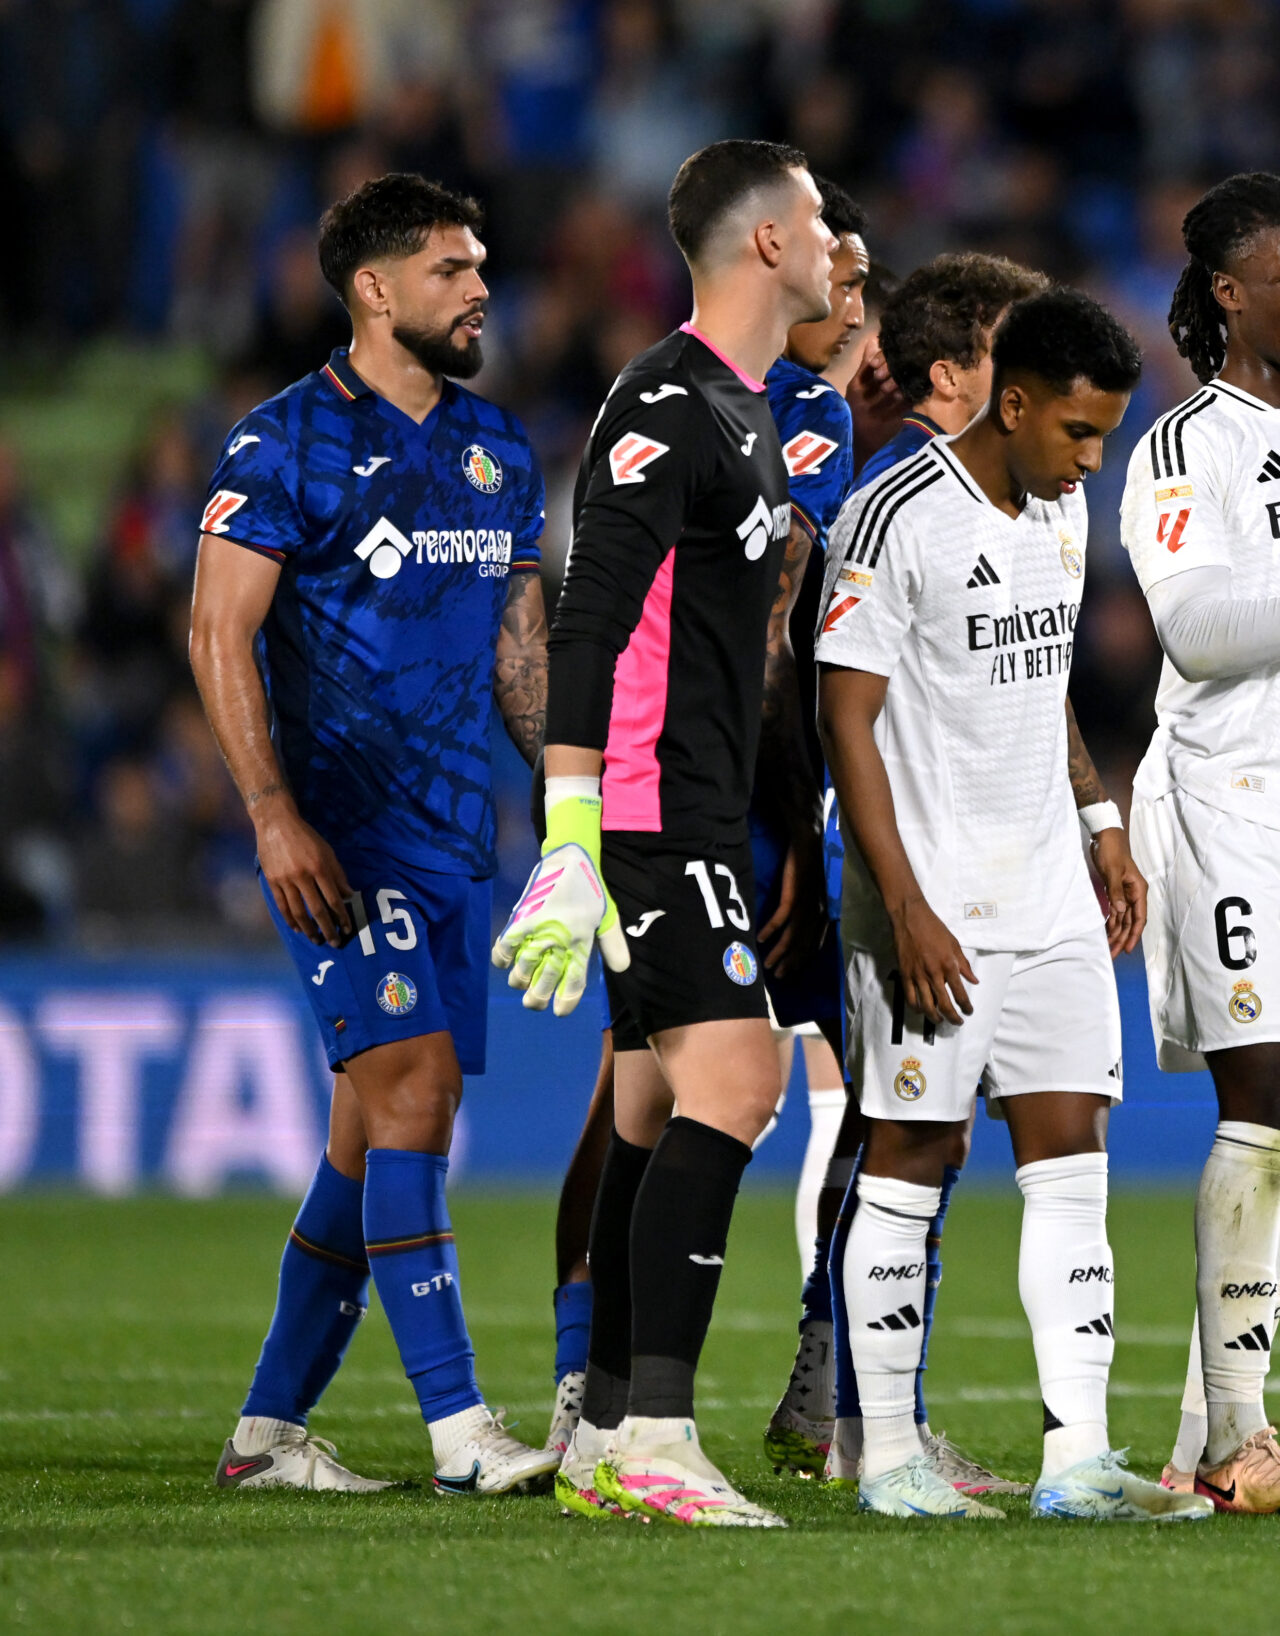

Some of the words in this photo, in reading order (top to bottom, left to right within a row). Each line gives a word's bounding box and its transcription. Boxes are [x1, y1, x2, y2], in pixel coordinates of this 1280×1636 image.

[412, 529, 512, 564] TECNOCASA
[965, 600, 1081, 652] Emirate
[684, 860, 751, 932] 13
[343, 888, 418, 957] 15
[1214, 896, 1257, 971] 6
[867, 1261, 925, 1282] RMCF
[1068, 1265, 1114, 1284] RMC
